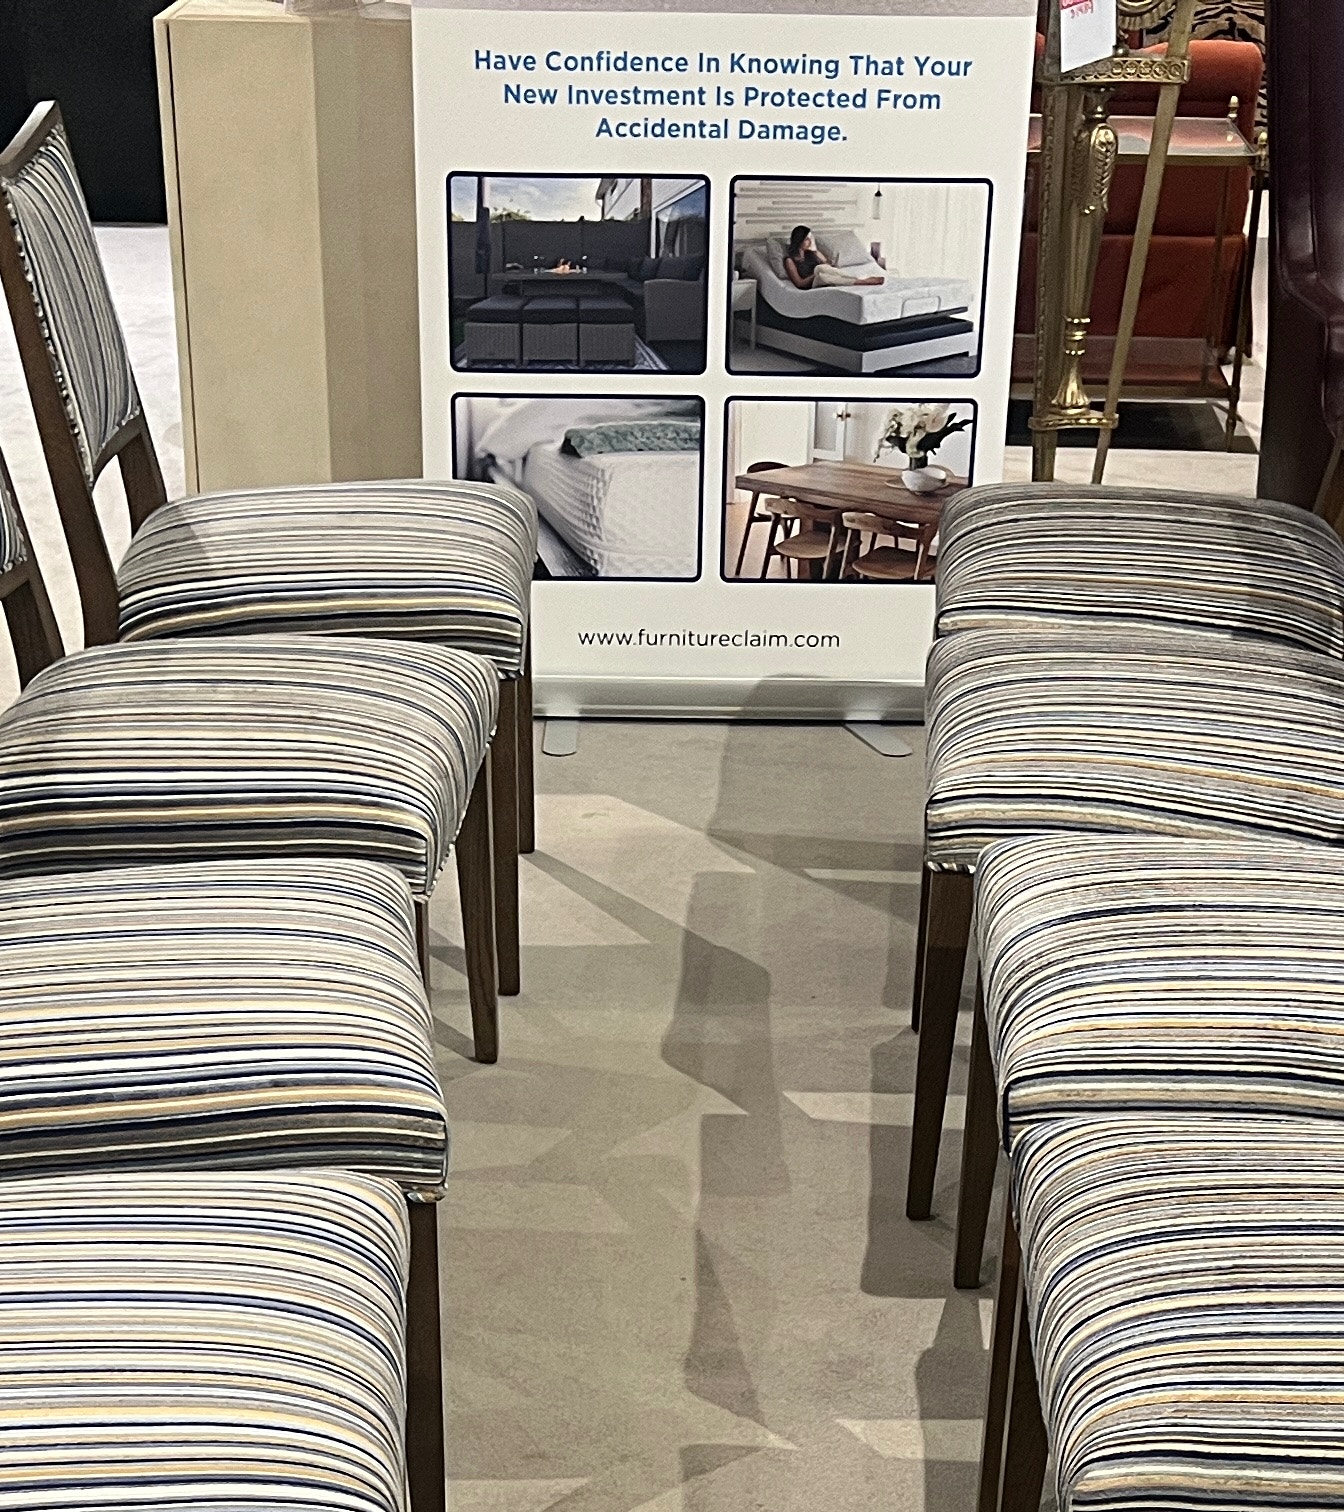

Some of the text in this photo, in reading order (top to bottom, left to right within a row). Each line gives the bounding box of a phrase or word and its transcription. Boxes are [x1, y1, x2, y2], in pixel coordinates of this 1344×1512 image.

[474, 49, 973, 80] Have Confidence In Knowing That Your
[504, 83, 941, 110] New Investment Is Protected From
[595, 117, 848, 145] Accidental Damage.
[577, 628, 840, 648] www.furnitureclaim.com
